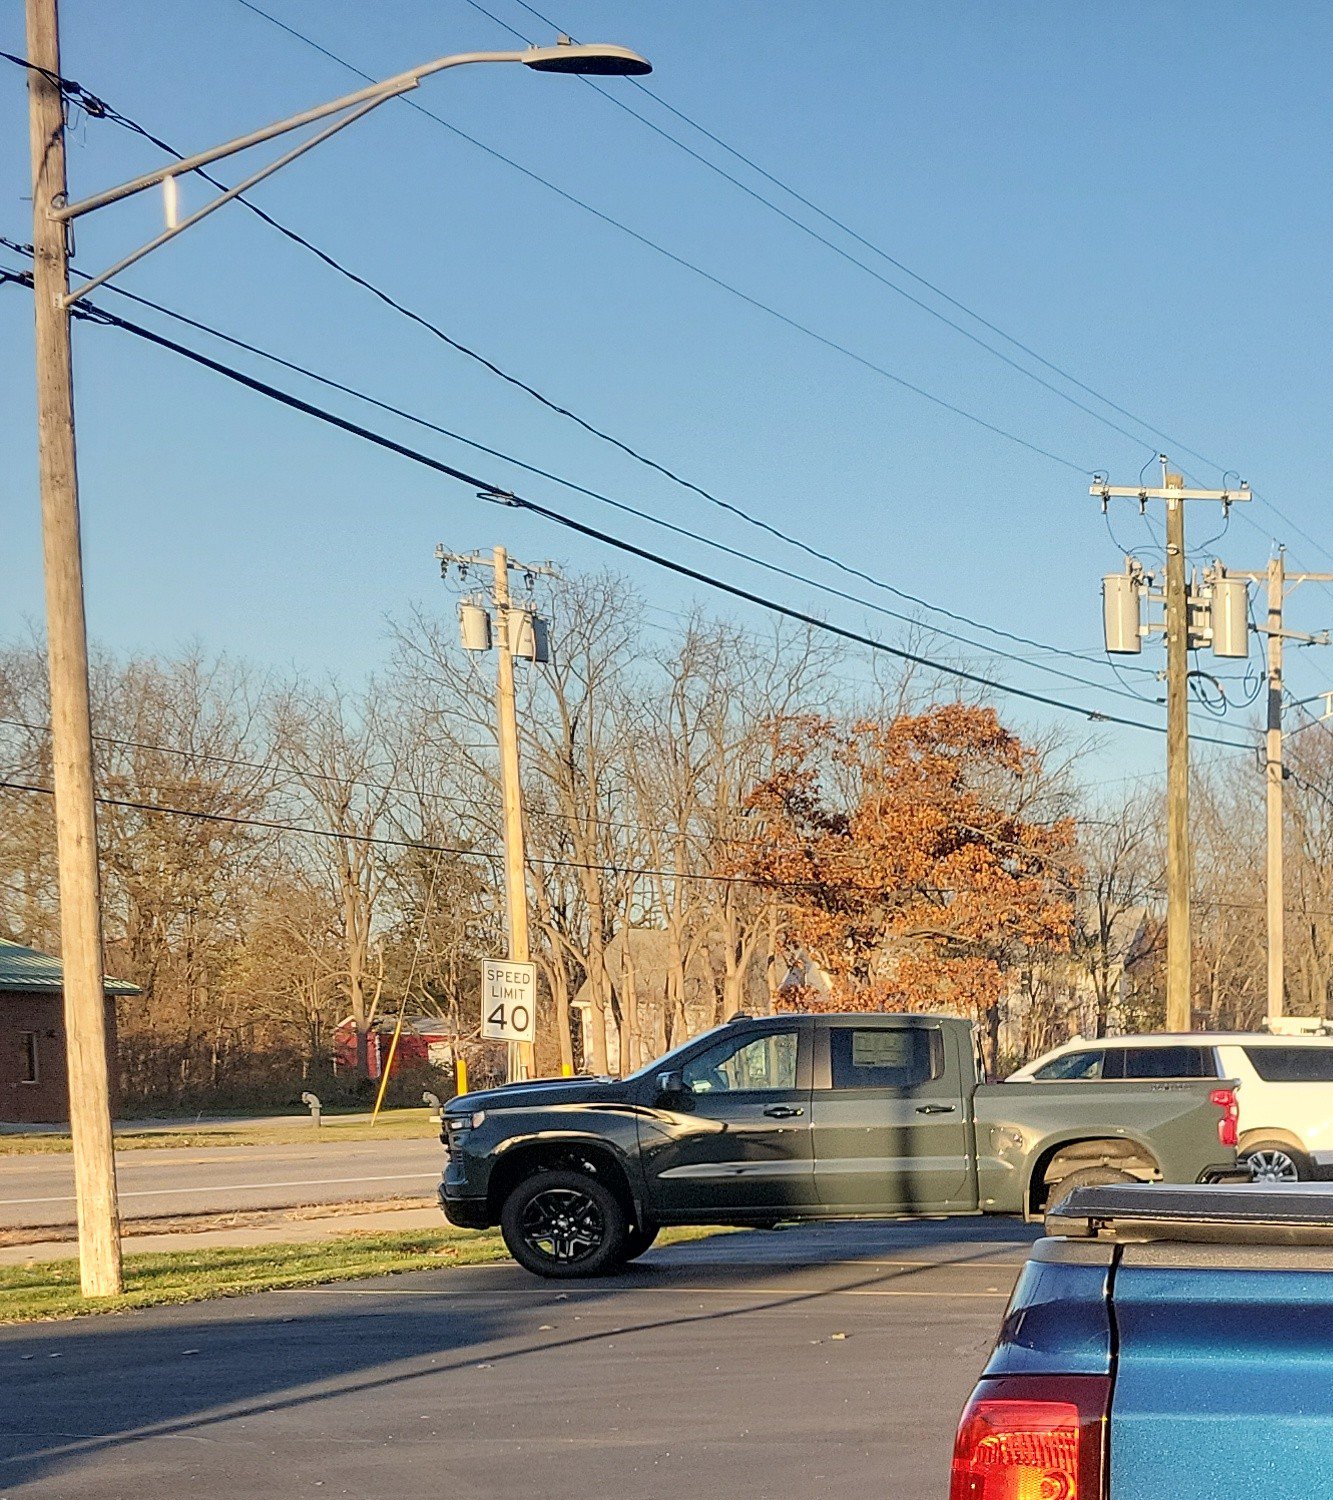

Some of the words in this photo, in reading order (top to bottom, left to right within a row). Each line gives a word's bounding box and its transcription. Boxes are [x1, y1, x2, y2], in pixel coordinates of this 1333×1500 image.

[487, 969, 530, 984] SPEED
[491, 985, 525, 1000] LIMIT
[487, 1003, 529, 1032] 40
